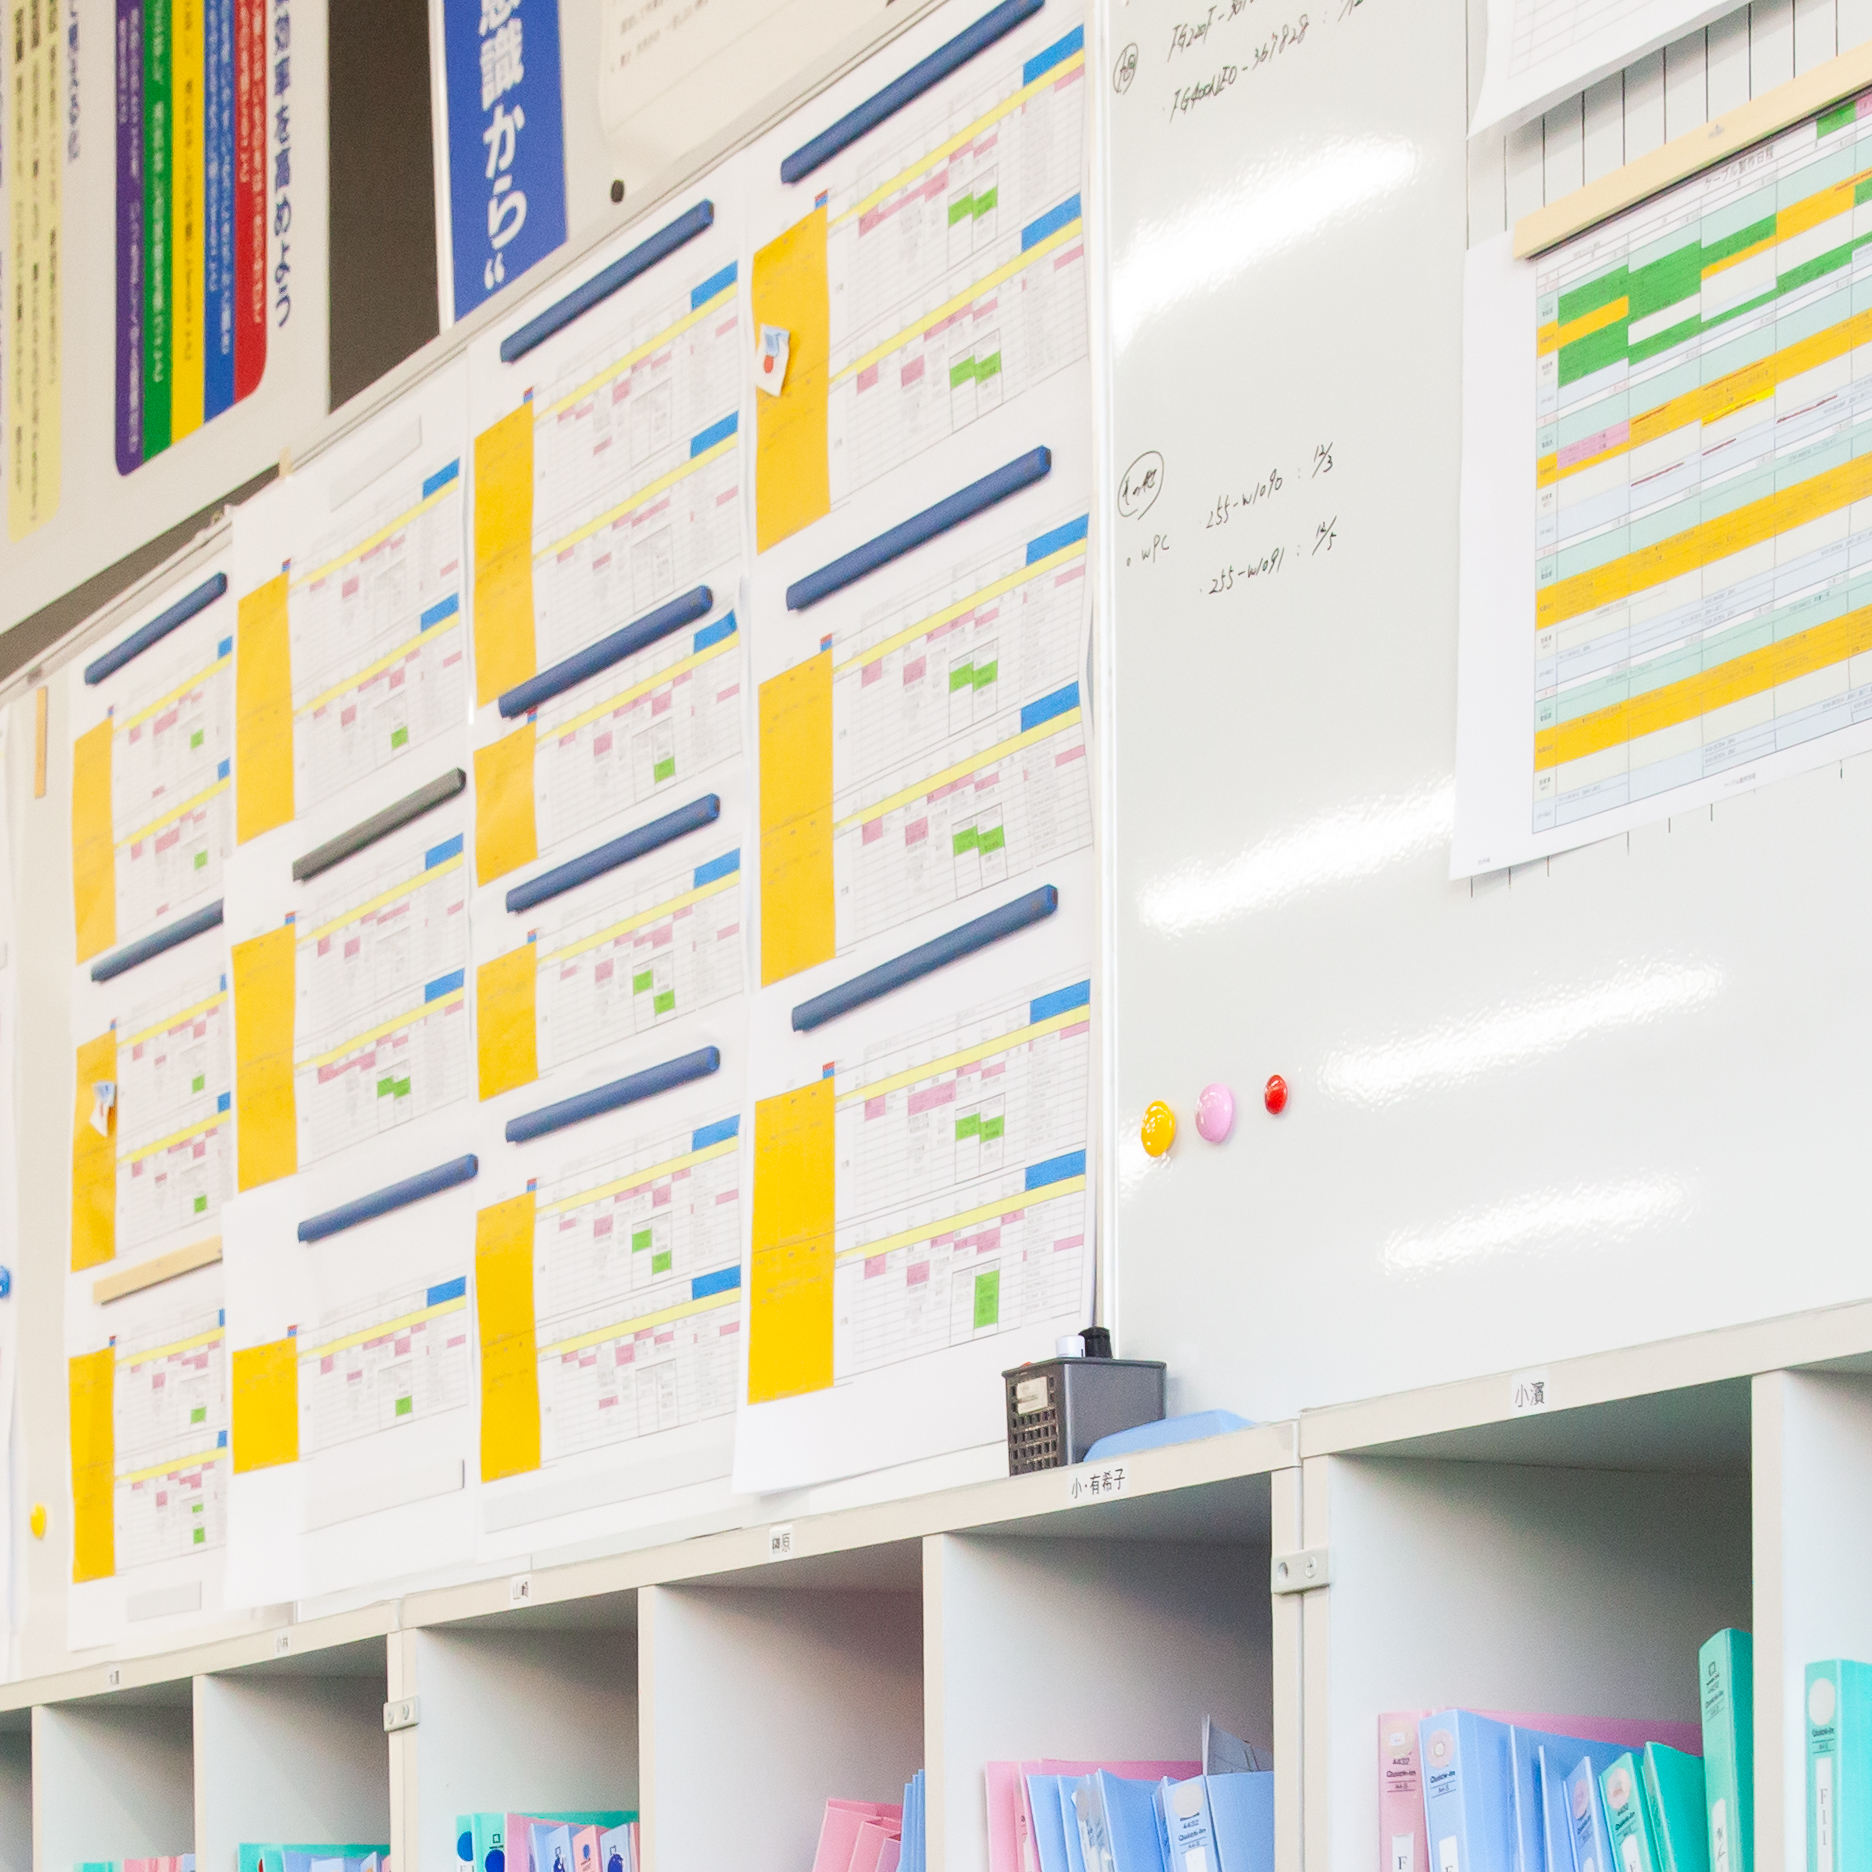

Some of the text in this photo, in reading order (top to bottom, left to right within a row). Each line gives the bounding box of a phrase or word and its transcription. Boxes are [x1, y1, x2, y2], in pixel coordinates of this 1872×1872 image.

[1071, 1467, 1126, 1499] 小・有希子
